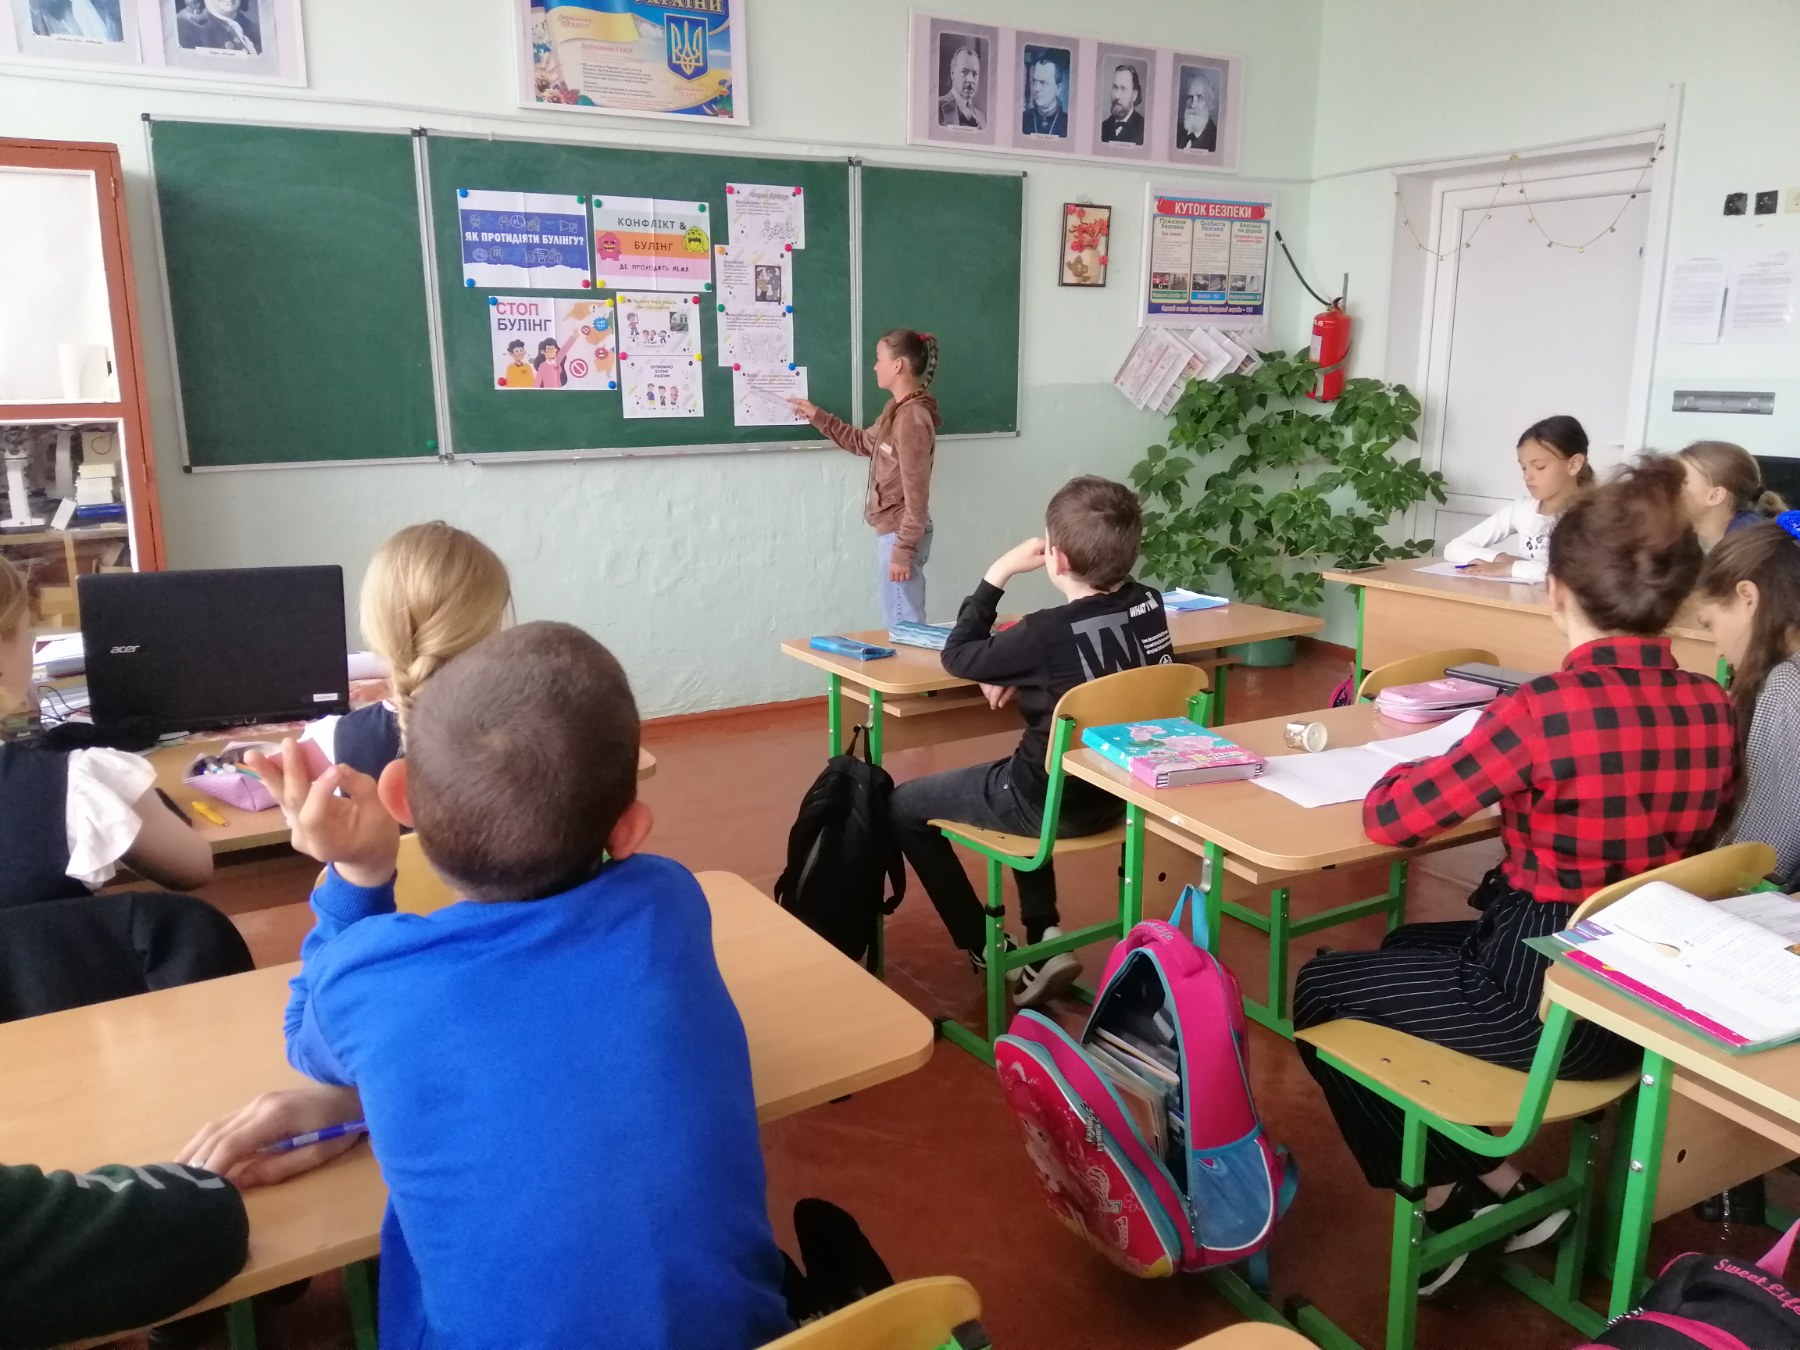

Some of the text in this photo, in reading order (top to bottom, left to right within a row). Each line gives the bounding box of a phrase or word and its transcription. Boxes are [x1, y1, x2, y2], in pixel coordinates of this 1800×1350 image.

[635, 0, 723, 12] АЇНИ
[1175, 202, 1252, 218] КУТОК БЕЗПЕКИ
[617, 217, 687, 230] КОНФЛІКТ &
[465, 231, 584, 246] ЯК ПРОТИДІЯТИ БУЛІНГУ?
[634, 241, 674, 251] БУЛІНГ
[496, 302, 539, 316] СТОП
[497, 318, 552, 332] БУЛІНГ
[110, 645, 140, 654] acer
[1713, 1258, 1768, 1287] Sweet
